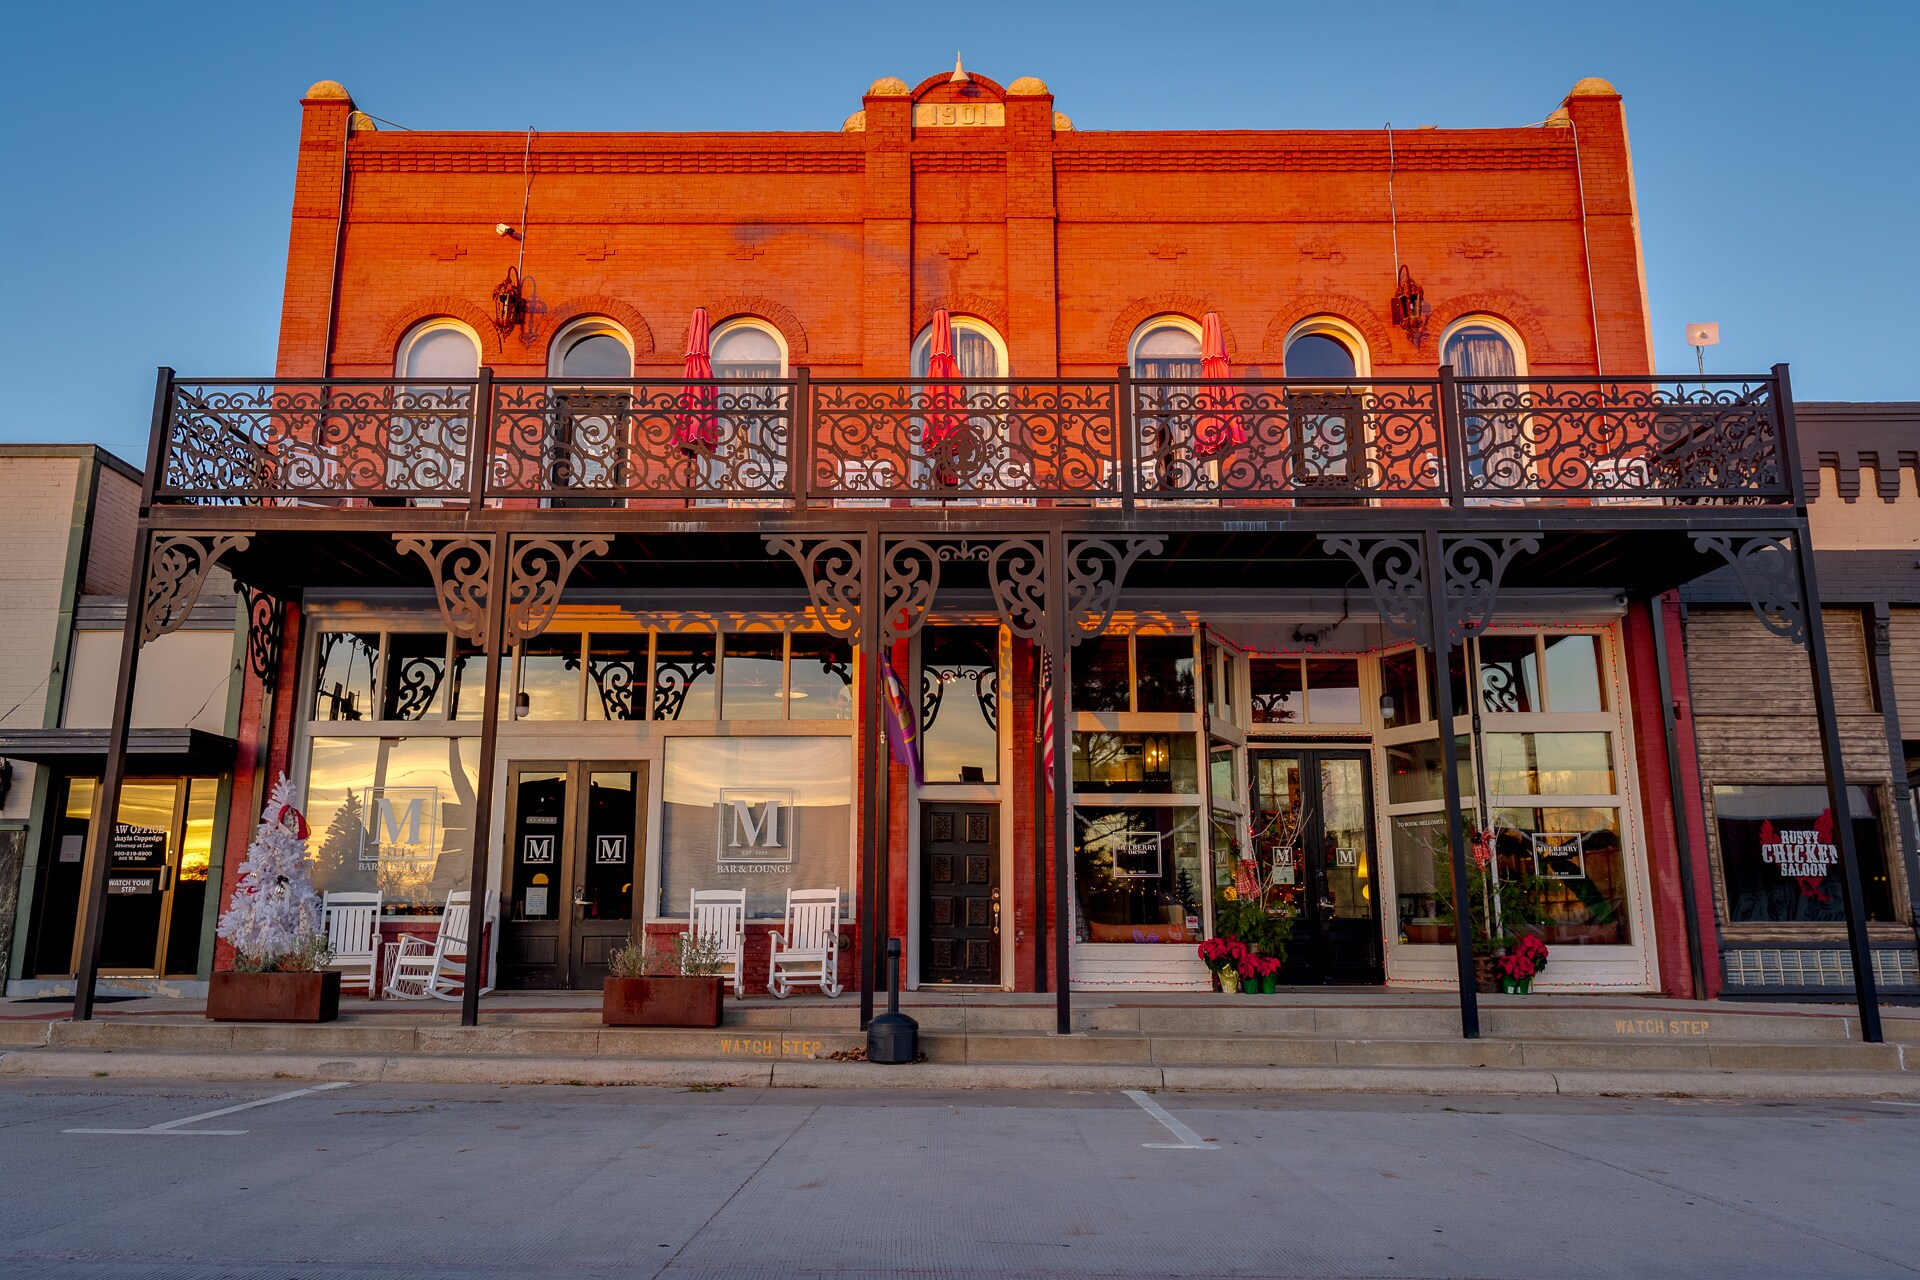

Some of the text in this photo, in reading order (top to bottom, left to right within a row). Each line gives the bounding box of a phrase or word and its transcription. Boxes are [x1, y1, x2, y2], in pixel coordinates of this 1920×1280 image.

[932, 105, 986, 125] 1901
[370, 798, 427, 844] M
[728, 800, 782, 848] M
[115, 825, 165, 834] AW OFFICE
[1780, 831, 1819, 844] RUSTY
[528, 840, 550, 858] M
[601, 840, 622, 858] M
[1276, 849, 1290, 862] M
[1340, 850, 1353, 863] M
[1762, 844, 1838, 863] CHICKEN
[359, 863, 378, 871] BAR
[717, 865, 792, 873] BAR & LOUNGE
[1781, 863, 1827, 876] SALOON
[1615, 1020, 1710, 1035] WATCH STEP
[721, 1040, 821, 1056] WATCH STEP
